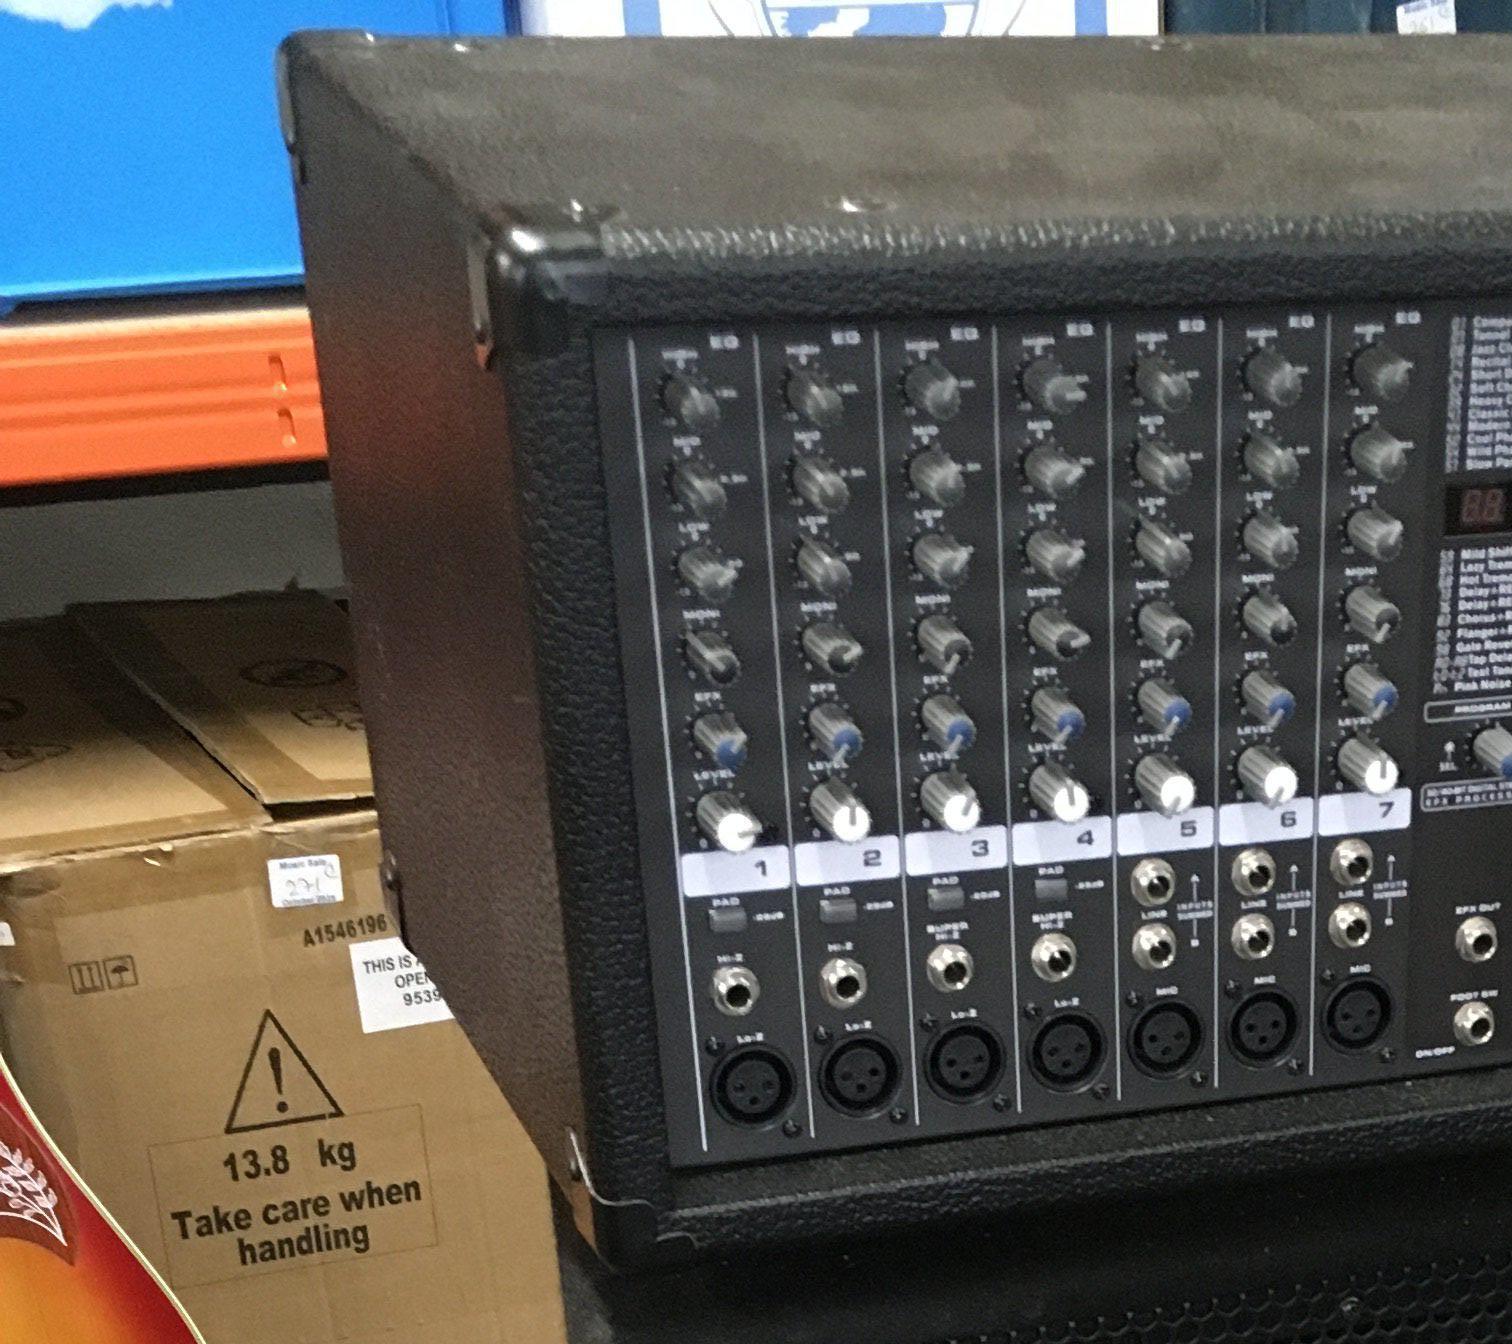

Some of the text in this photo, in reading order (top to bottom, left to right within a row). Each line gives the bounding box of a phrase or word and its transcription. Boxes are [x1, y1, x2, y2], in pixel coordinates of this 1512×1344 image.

[1480, 678, 1512, 690] Noise
[1379, 801, 1394, 818] 7
[1280, 811, 1297, 827] 6
[1180, 820, 1197, 837] 5
[1077, 830, 1094, 846] 4
[971, 839, 989, 857] 3
[863, 849, 882, 867] 2
[755, 860, 767, 877] 1
[1038, 865, 1065, 875] PAD
[932, 876, 959, 886] PAD
[823, 886, 851, 896] PAD
[1338, 889, 1364, 900] LINE
[712, 896, 740, 907] PAD
[1240, 899, 1267, 910] LINE
[1141, 909, 1168, 920] LINE
[303, 913, 388, 948] A1546196
[362, 956, 396, 975] THIS
[398, 954, 413, 969] IS
[1349, 963, 1372, 974] MIC
[394, 970, 431, 990] OPE
[1253, 974, 1276, 985] MIC
[1156, 985, 1178, 996] MIC
[223, 1138, 357, 1182] 13.8 kg
[170, 1180, 422, 1240] Take care when
[237, 1224, 370, 1267] handling
